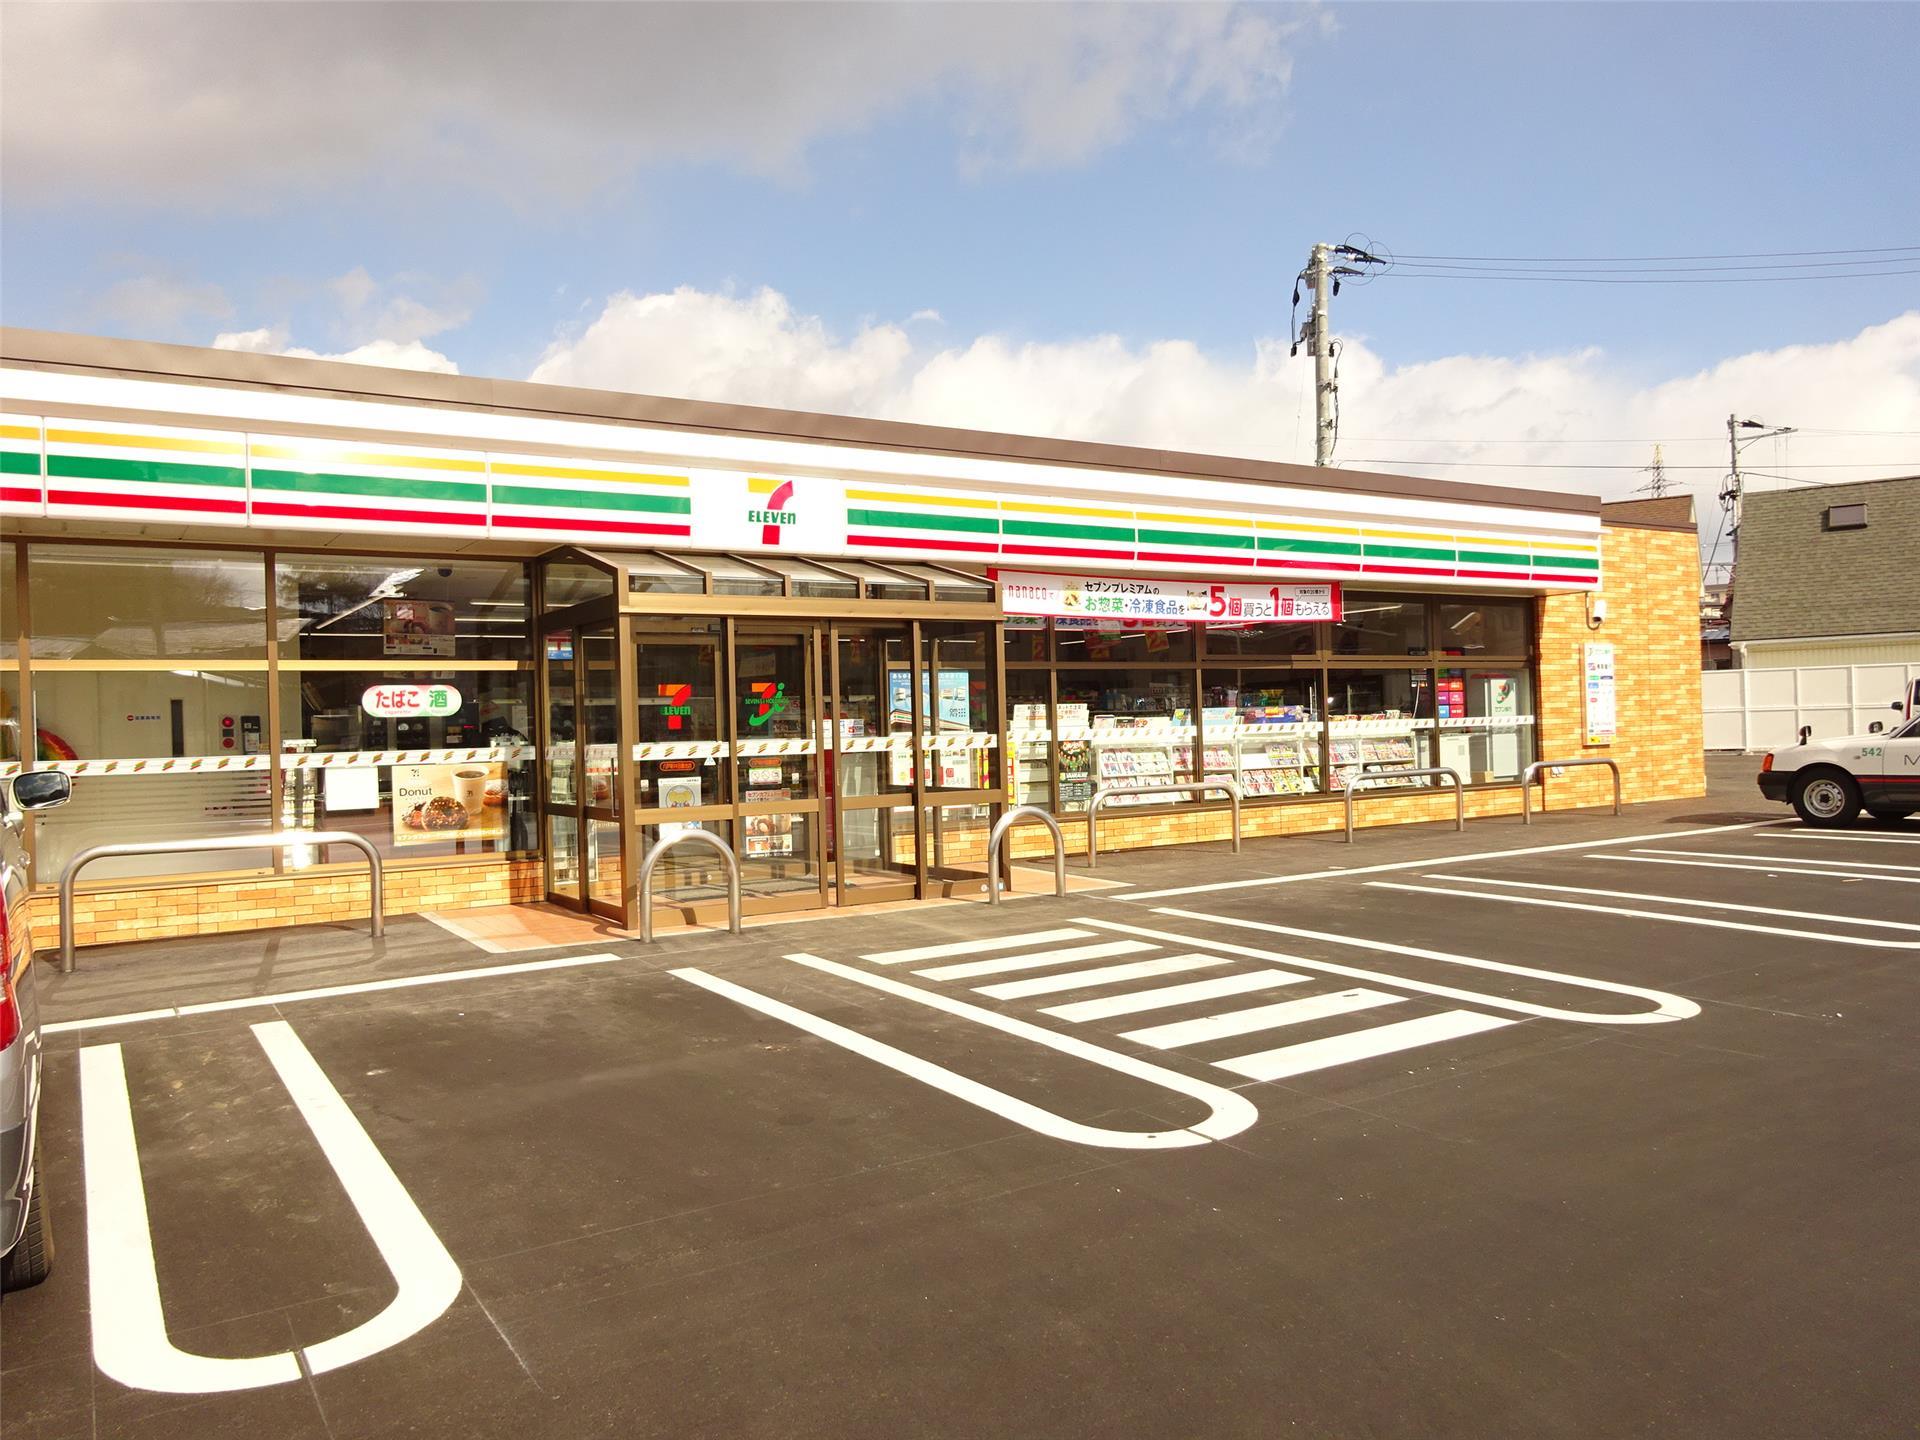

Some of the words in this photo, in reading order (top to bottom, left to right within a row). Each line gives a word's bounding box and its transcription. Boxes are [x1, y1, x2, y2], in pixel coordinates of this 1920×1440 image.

[1085, 581, 1159, 595] セブンプレミアムの
[376, 690, 420, 708] たばこ
[428, 689, 448, 708] 酒
[1862, 747, 1882, 756] 542
[399, 787, 433, 797] Donut
